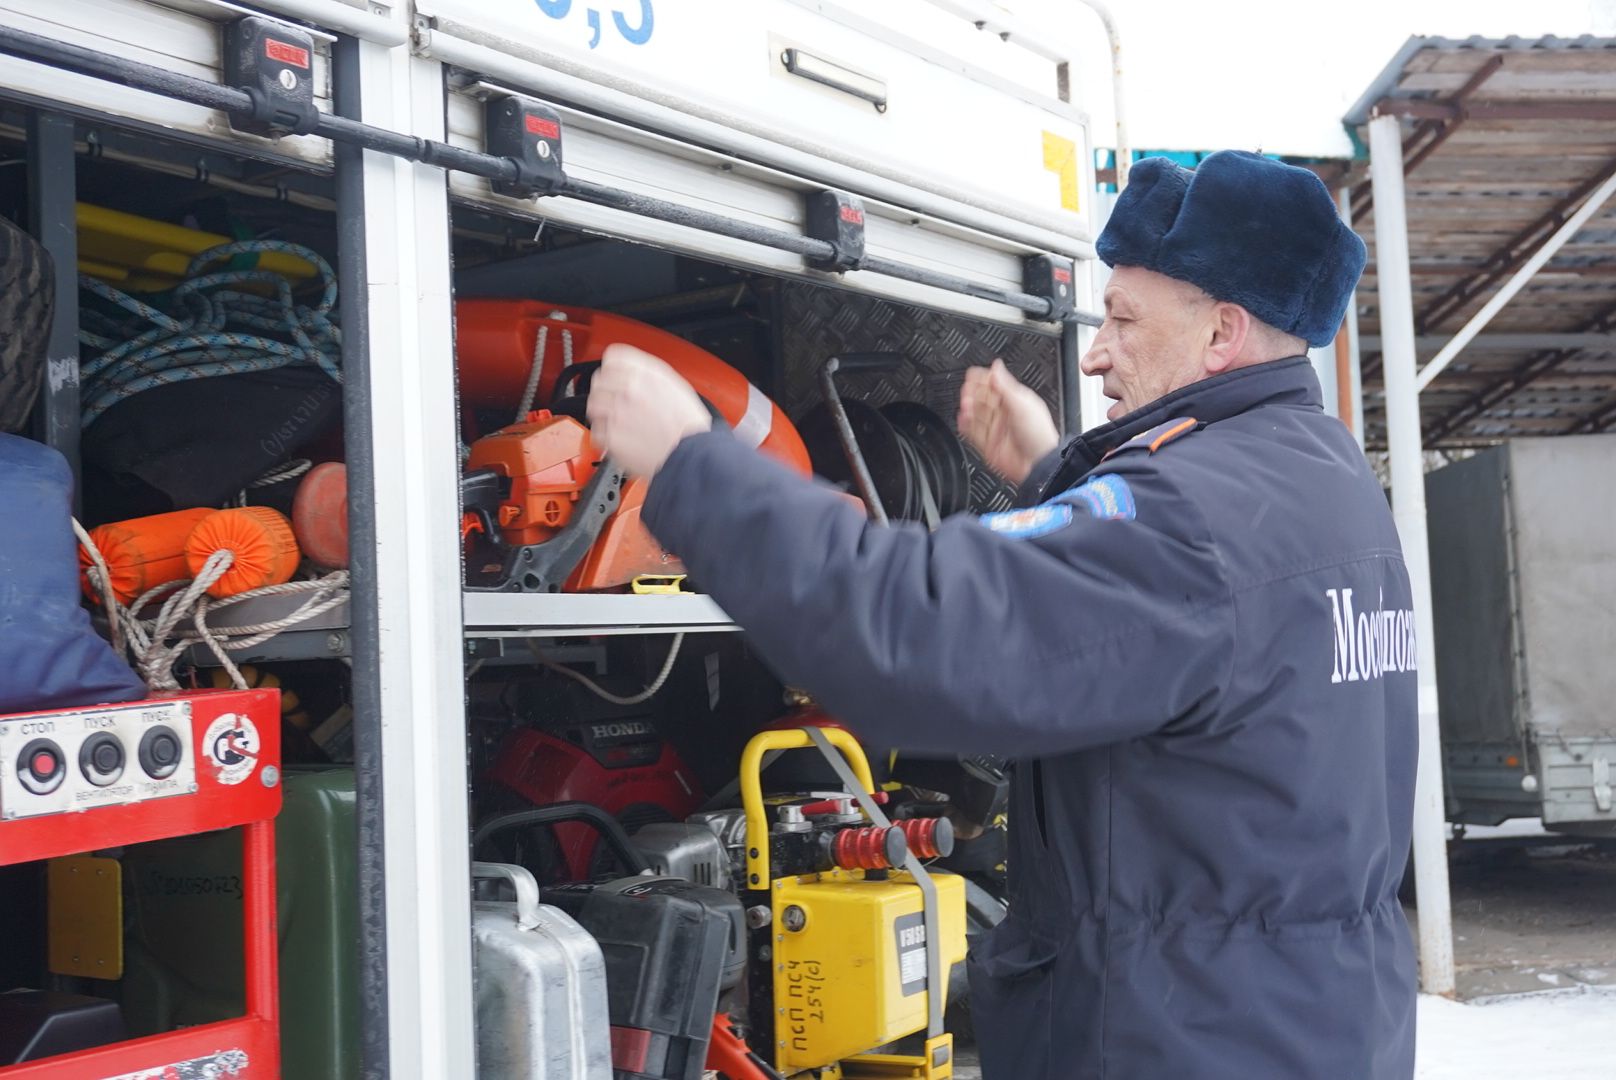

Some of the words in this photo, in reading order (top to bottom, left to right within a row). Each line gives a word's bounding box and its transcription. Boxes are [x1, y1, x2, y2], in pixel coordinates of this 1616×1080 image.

[20, 721, 56, 735] СТОП
[83, 715, 117, 729] ПУСК
[591, 722, 657, 738] HONDA
[789, 1008, 808, 1051] ПСП
